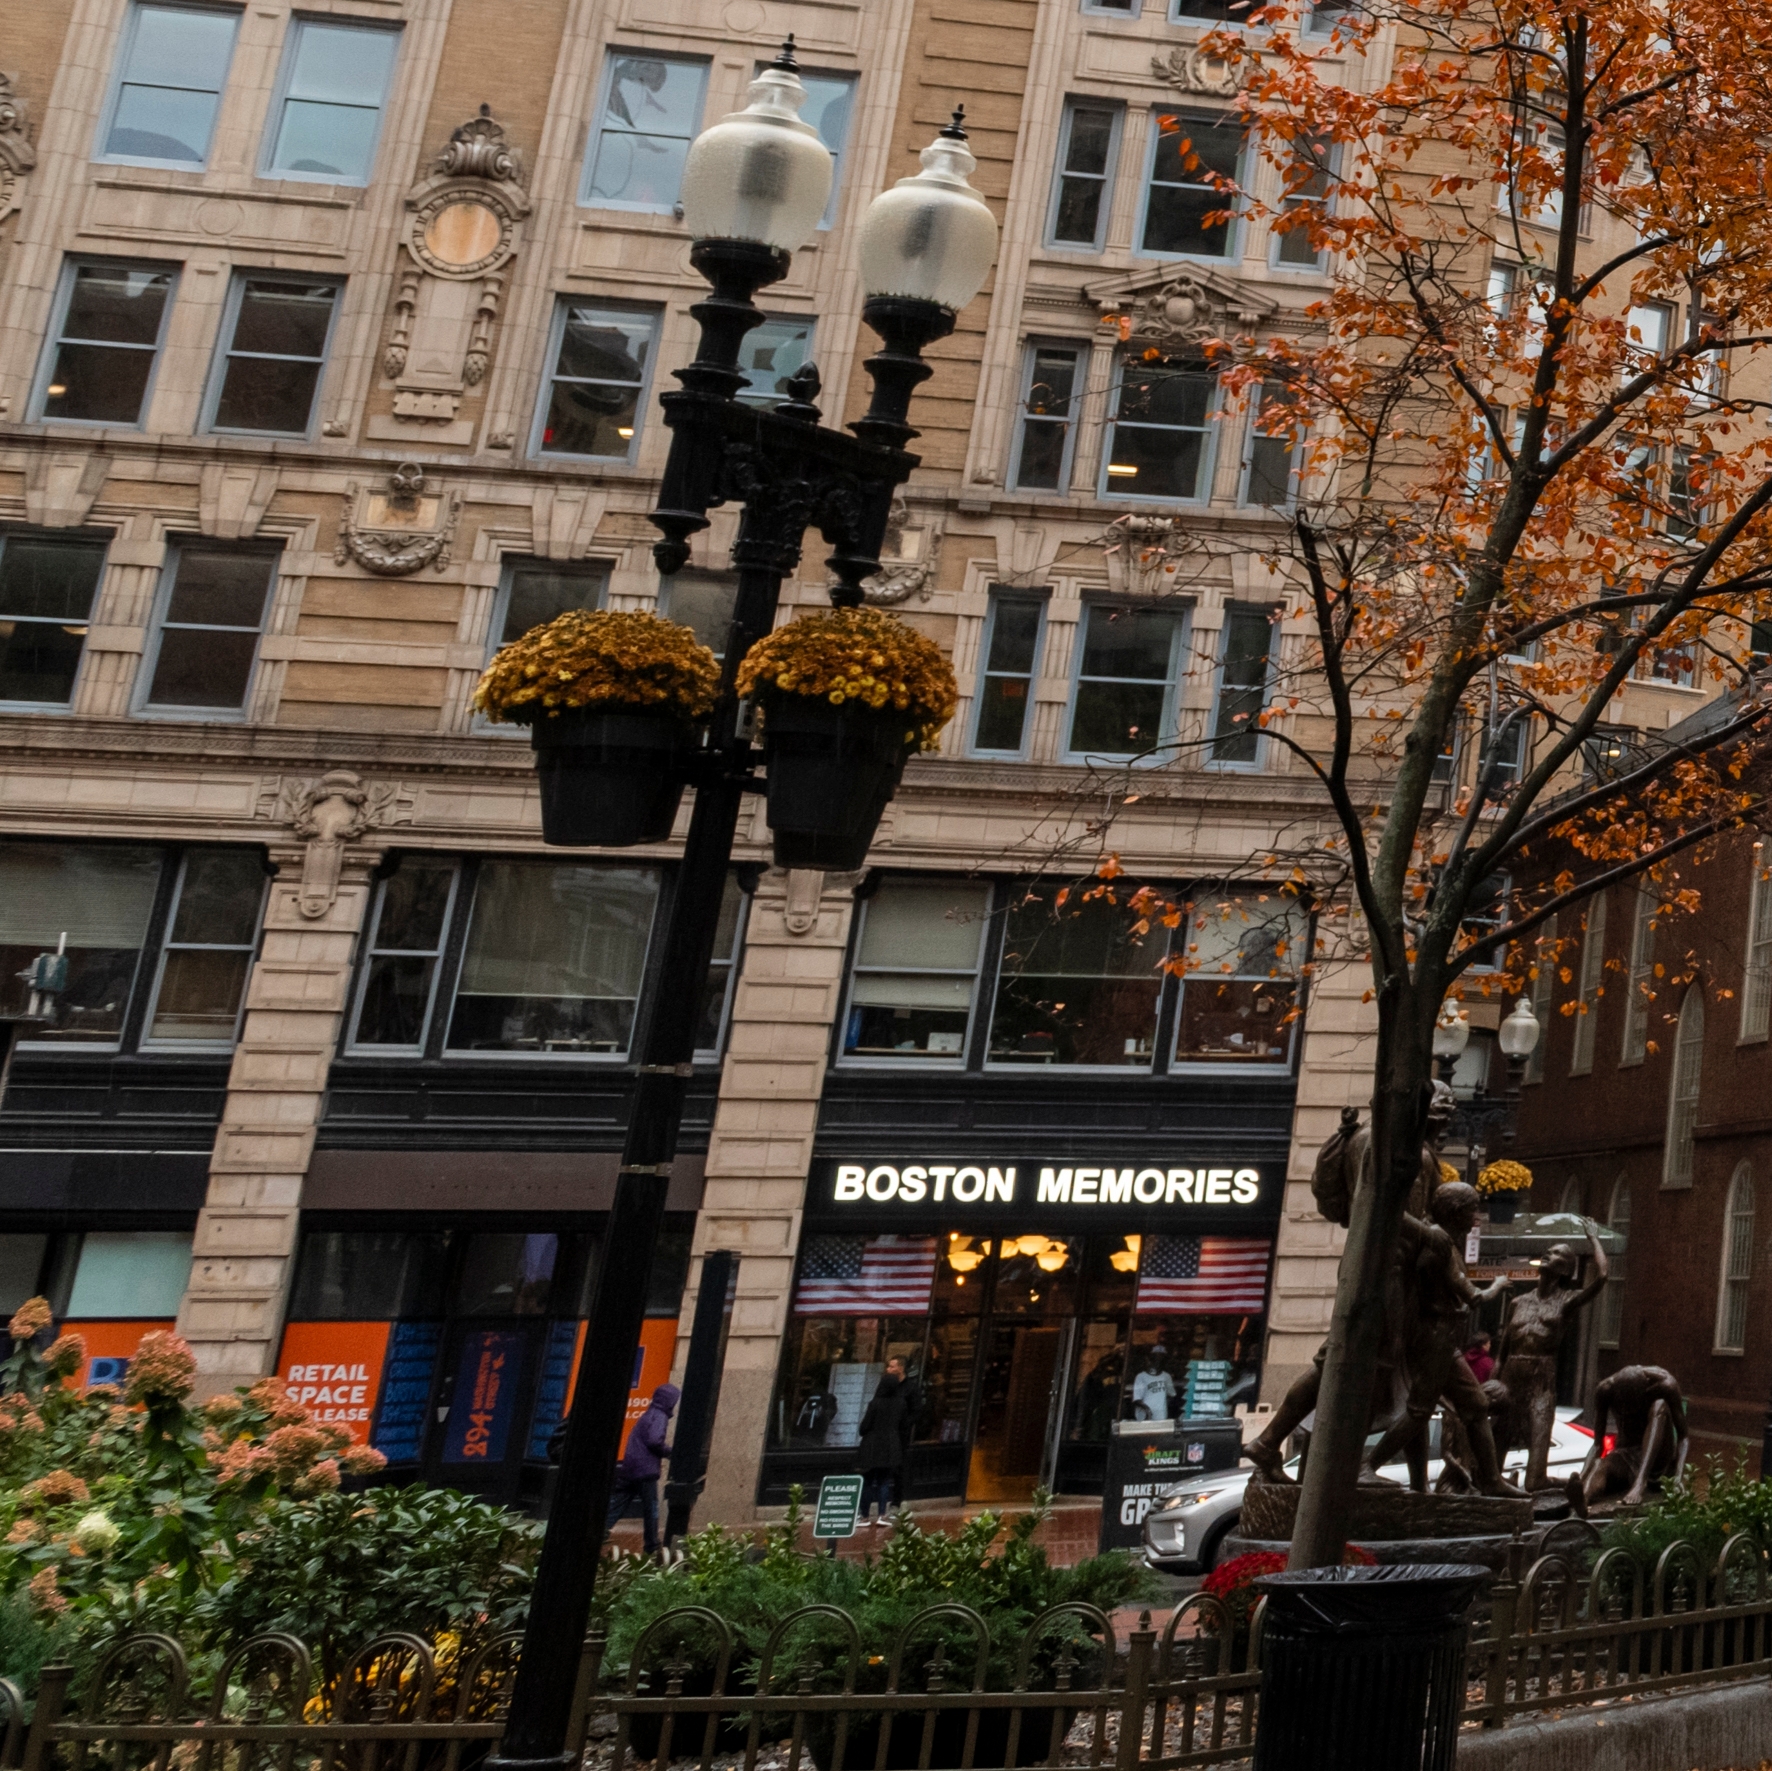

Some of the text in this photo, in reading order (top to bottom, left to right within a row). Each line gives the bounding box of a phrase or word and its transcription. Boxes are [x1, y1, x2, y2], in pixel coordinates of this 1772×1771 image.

[834, 1166, 1259, 1204] BOSTON MEMORIES
[288, 1364, 370, 1382] RETAIL
[285, 1386, 368, 1405] SPACE
[313, 1408, 370, 1421] LEASE
[462, 1412, 494, 1457] 294
[1145, 1449, 1182, 1460] DRAFT
[1148, 1456, 1180, 1466] KINGS
[824, 1484, 858, 1493] PLEASE
[1122, 1483, 1153, 1497] MAKE
